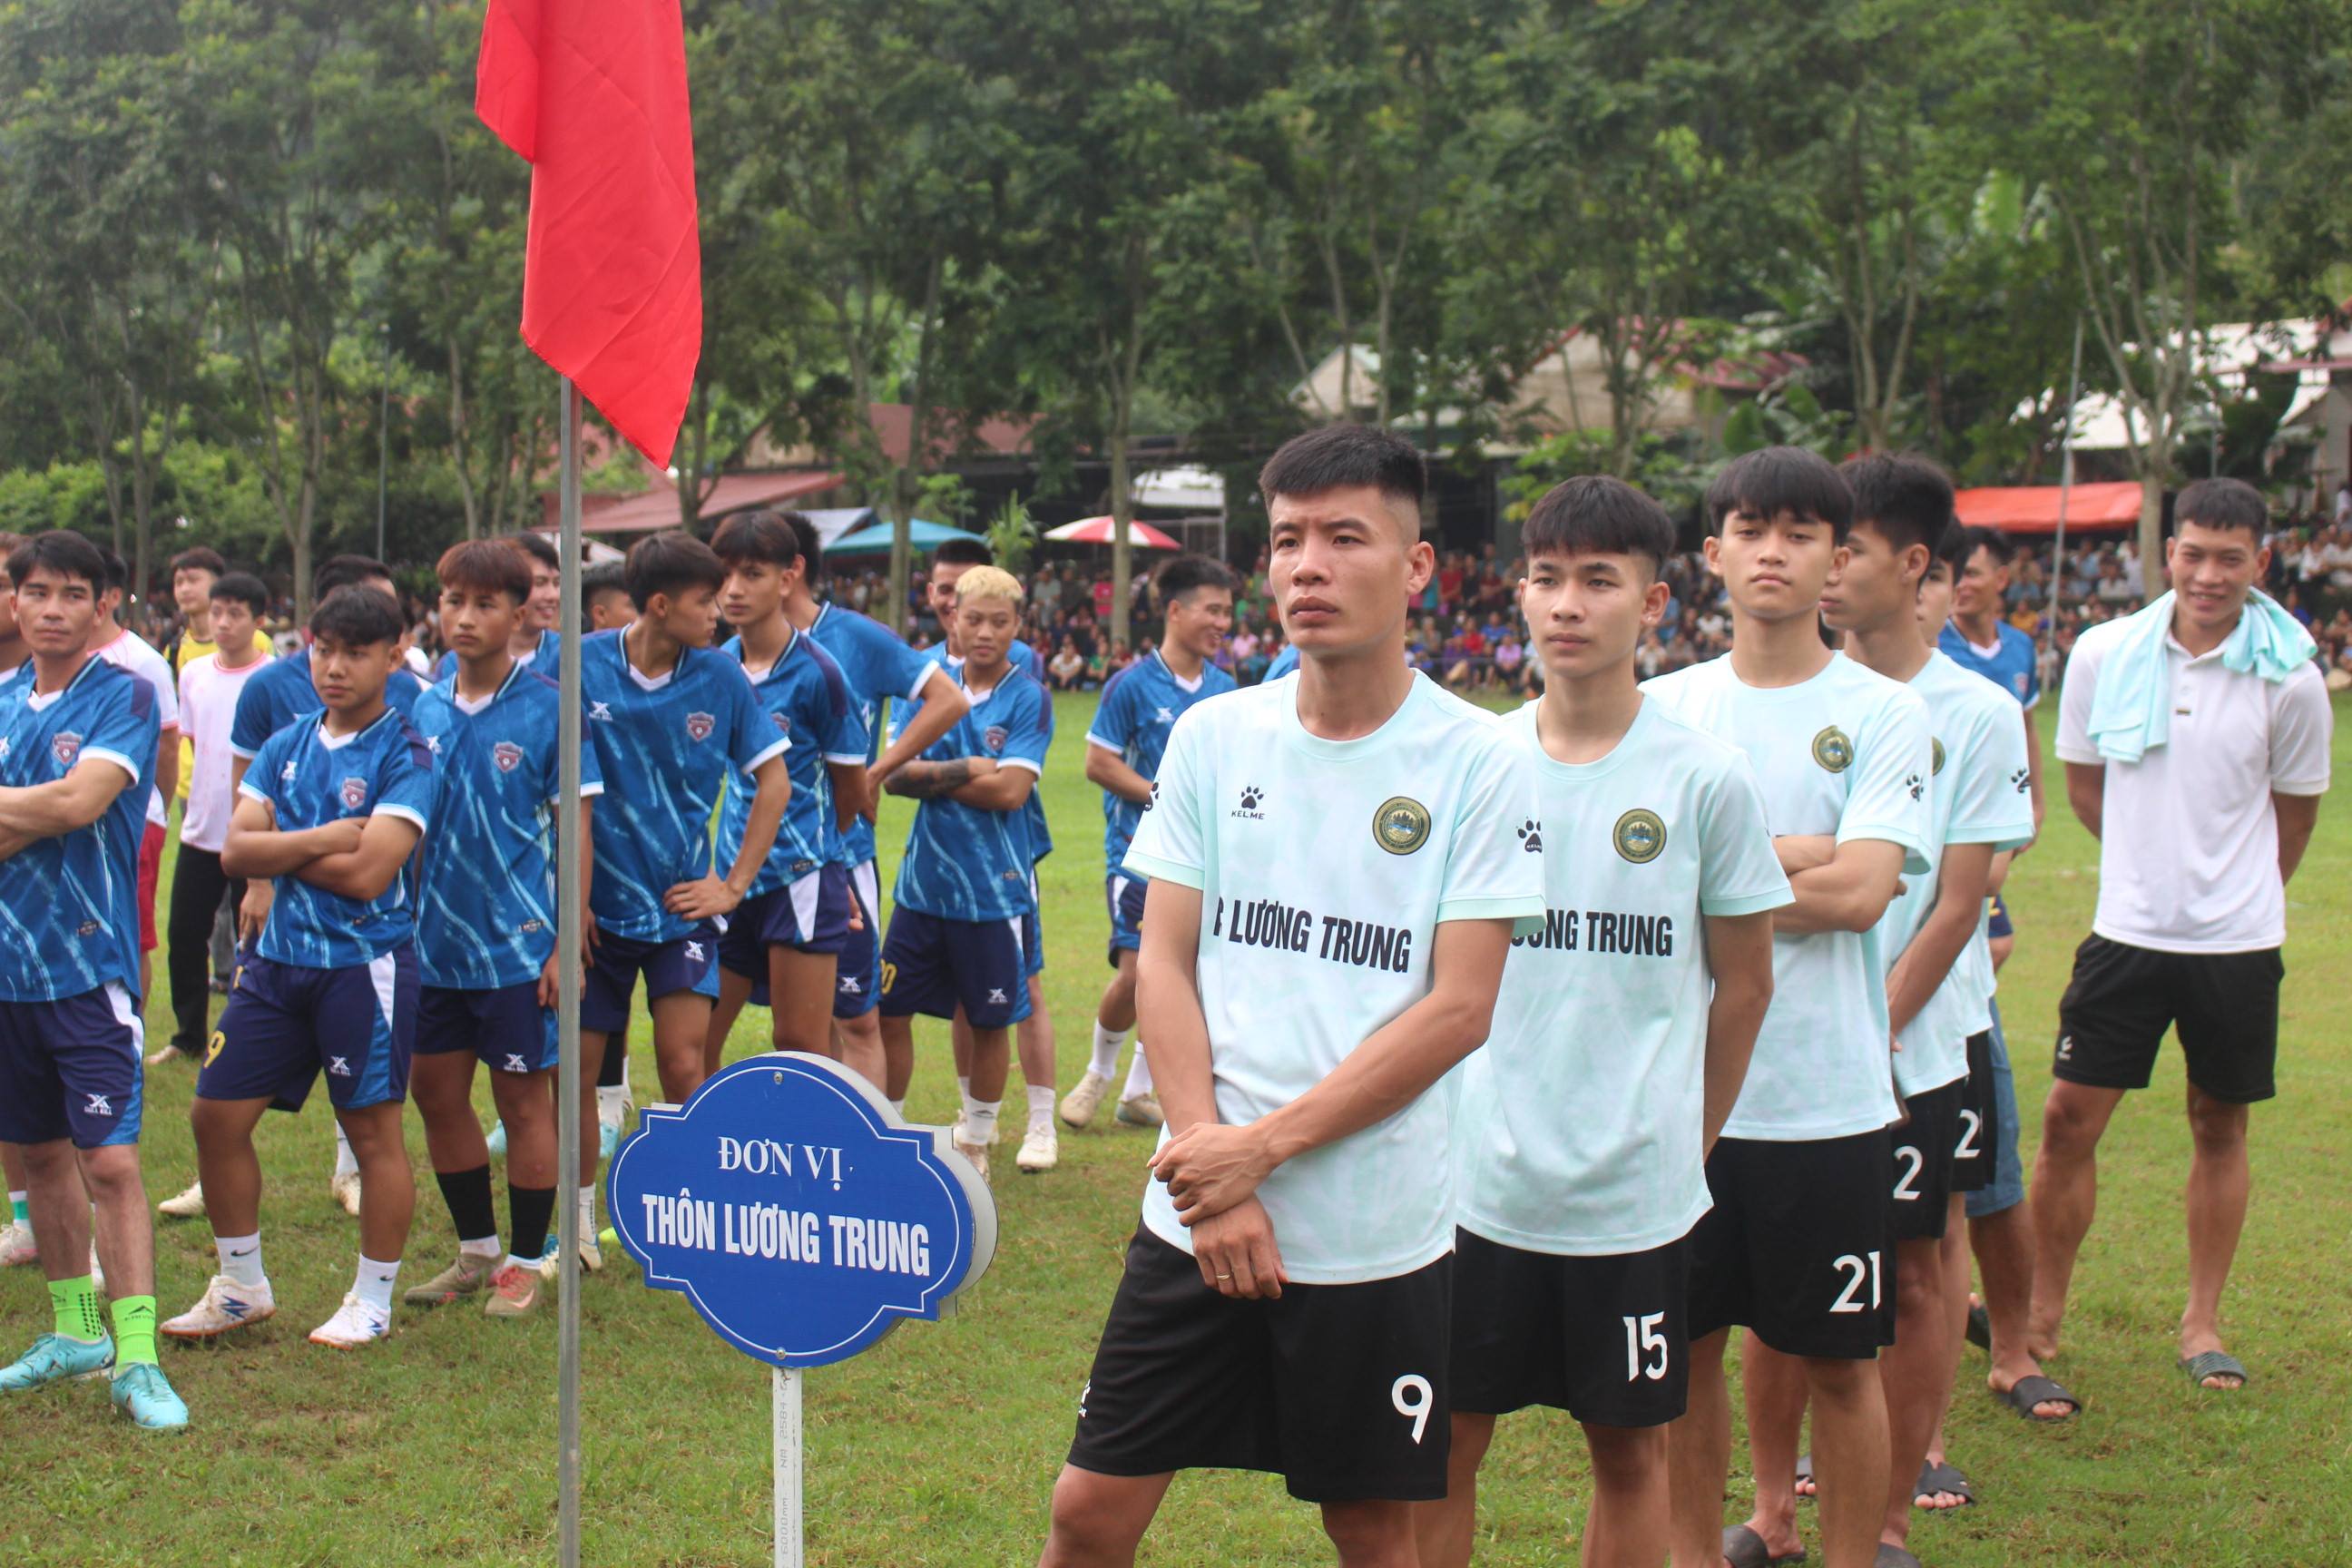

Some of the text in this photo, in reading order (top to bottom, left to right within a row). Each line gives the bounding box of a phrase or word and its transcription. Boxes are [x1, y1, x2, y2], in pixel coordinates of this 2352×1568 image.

[1231, 809, 1265, 820] KELME
[1229, 898, 1313, 953] LƯƠNG
[1319, 916, 1412, 974] TRUNG
[1511, 908, 1672, 956] NG TRUNG
[718, 1136, 844, 1191] ĐƠN VỊ
[642, 1187, 716, 1250] THÔN
[725, 1200, 820, 1264] LƯƠNG
[828, 1214, 930, 1277] TRUNG
[1829, 1250, 1881, 1312] 21
[1622, 1311, 1669, 1382] 15
[1391, 1374, 1434, 1445] 9
